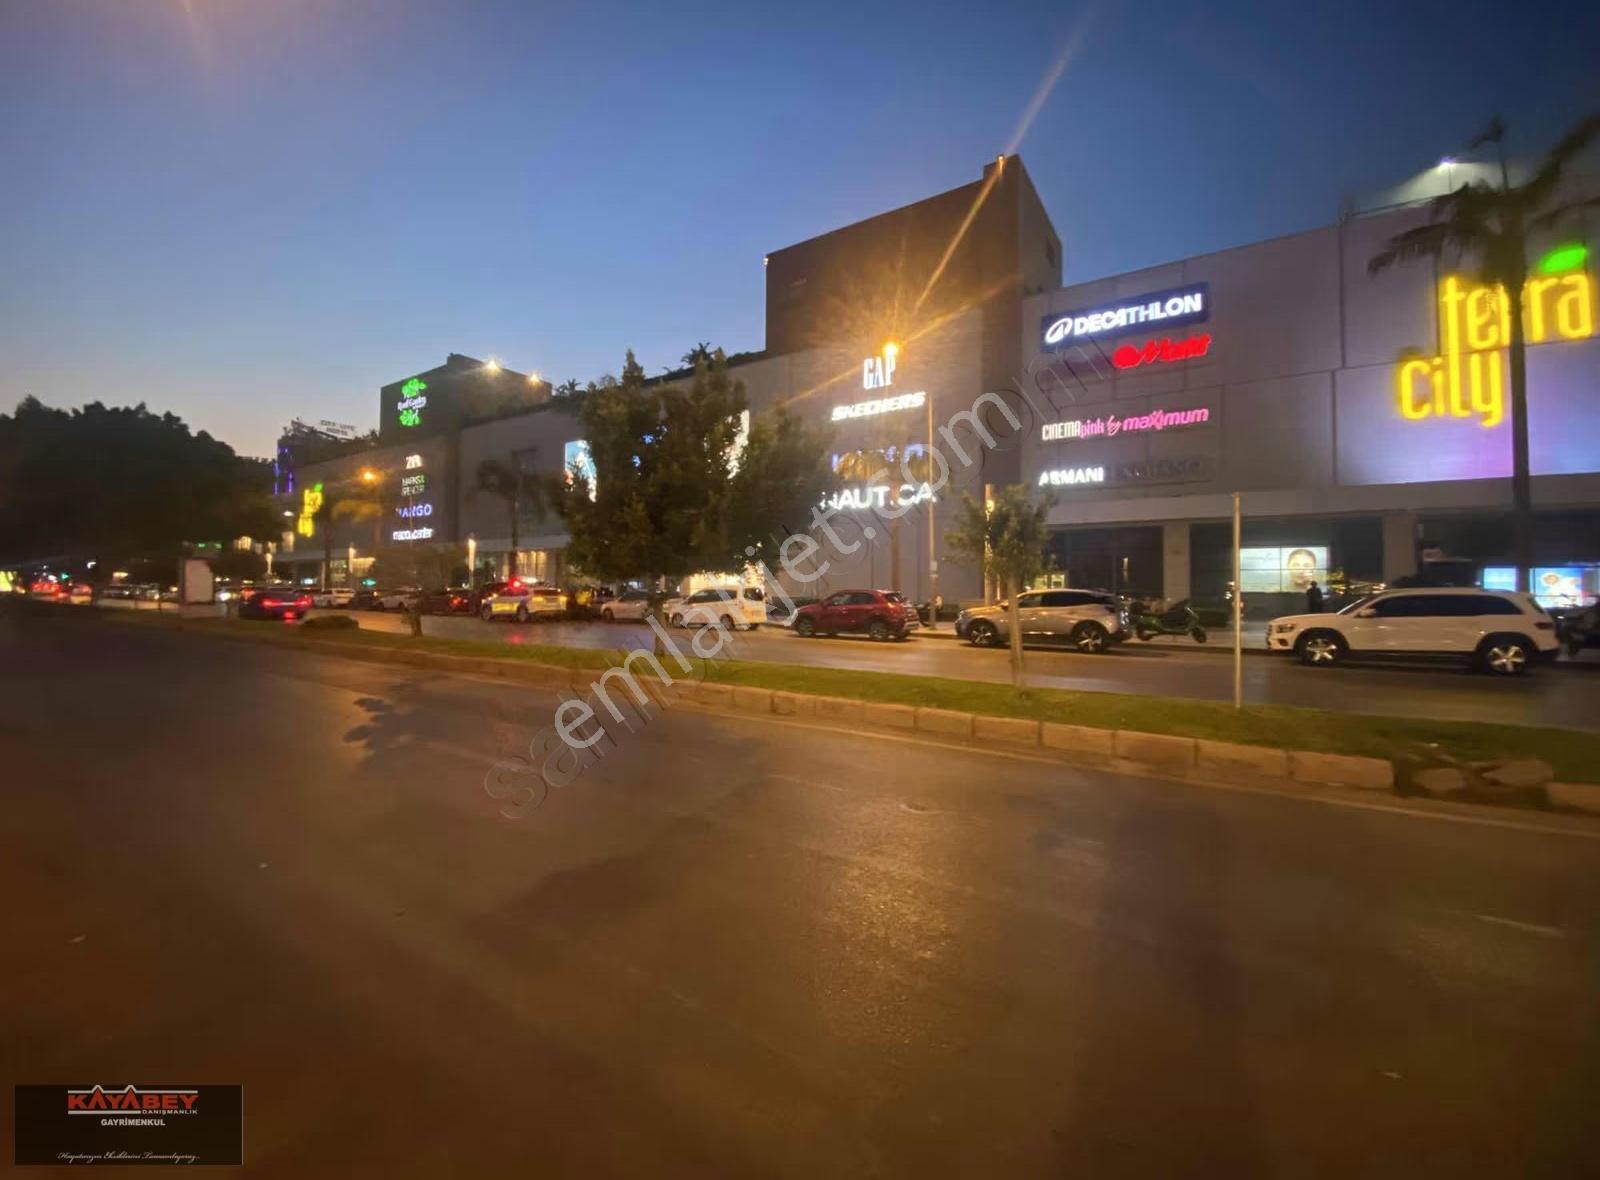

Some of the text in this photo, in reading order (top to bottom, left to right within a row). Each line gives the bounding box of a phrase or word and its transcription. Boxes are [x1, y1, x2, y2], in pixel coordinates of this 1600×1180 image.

[1073, 292, 1203, 336] DECATHLON
[863, 352, 897, 390] GAP
[1400, 351, 1504, 428] city
[1106, 415, 1122, 436] by
[1038, 466, 1105, 487] ARMANI
[395, 503, 433, 517] ANGO
